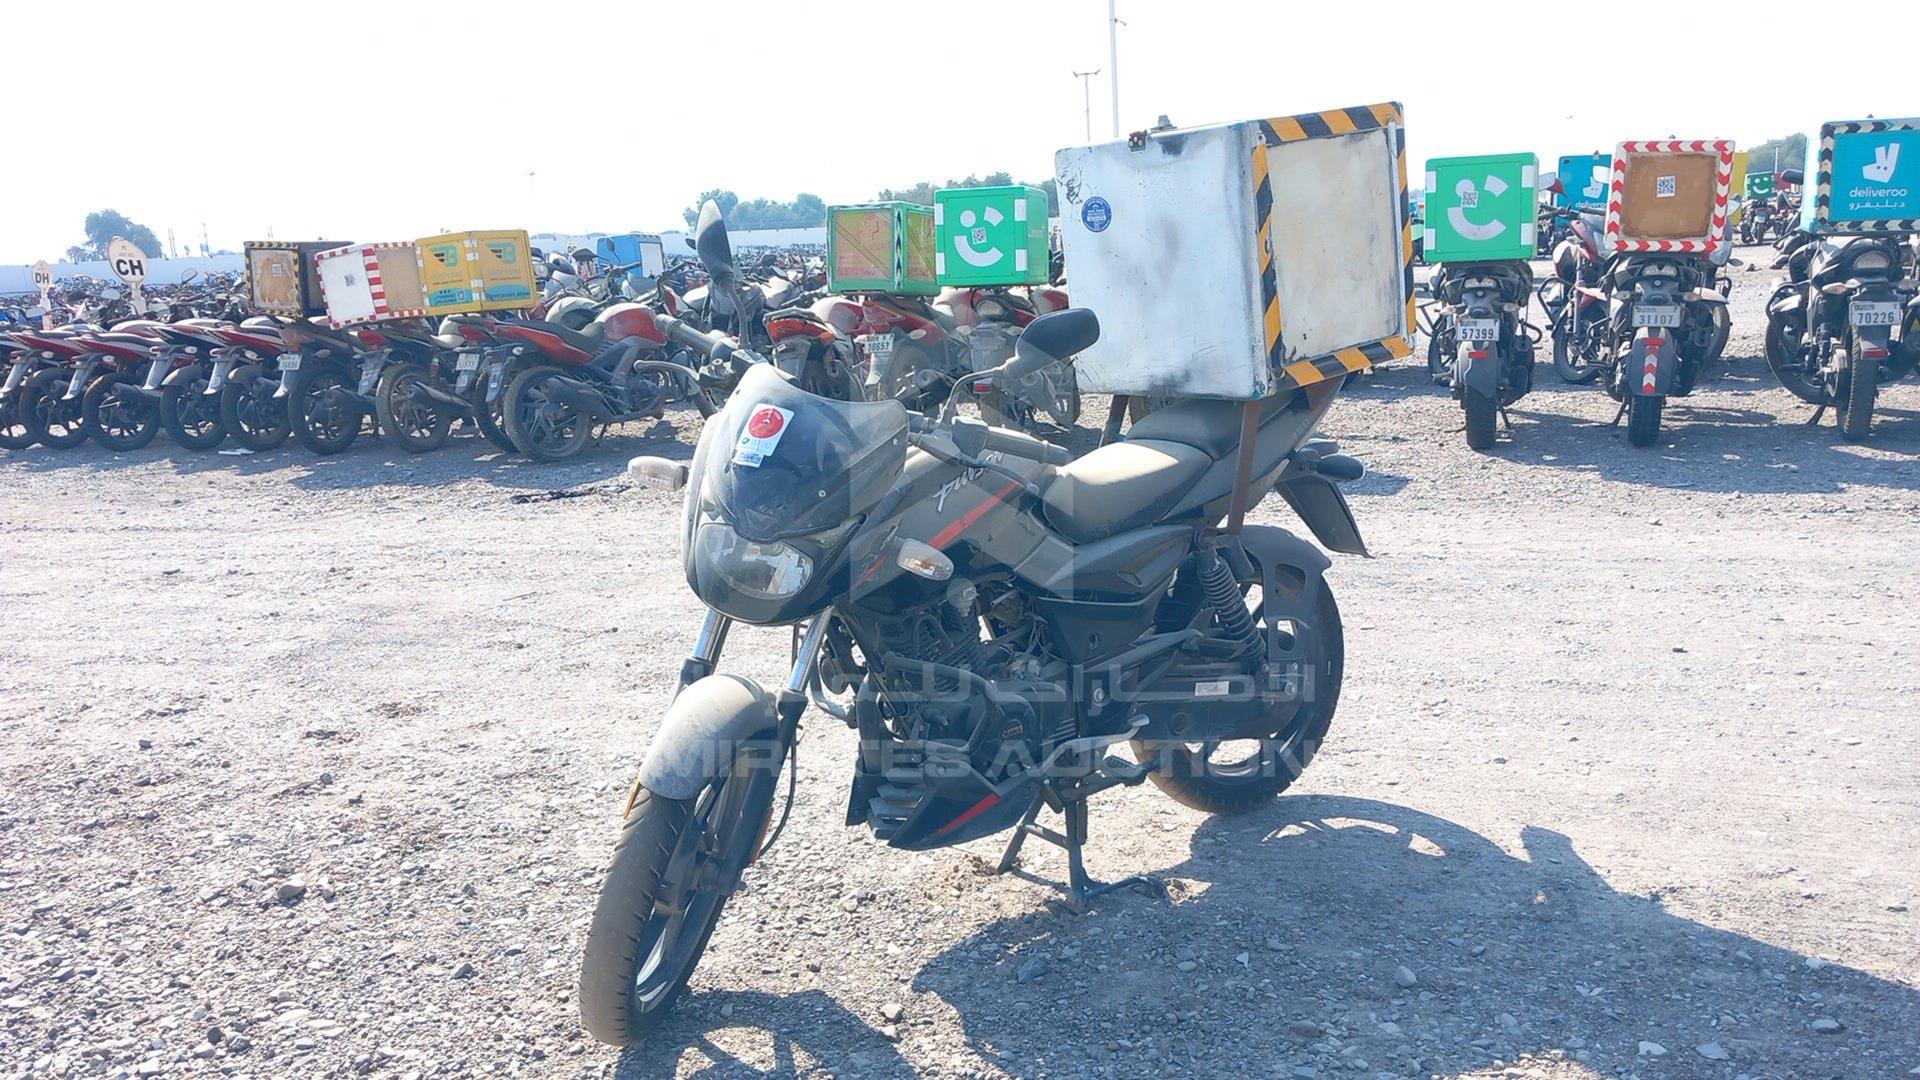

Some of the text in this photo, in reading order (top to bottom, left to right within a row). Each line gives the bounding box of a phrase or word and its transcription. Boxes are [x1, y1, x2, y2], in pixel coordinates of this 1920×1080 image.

[1849, 186, 1908, 198] deliveroo
[115, 259, 145, 276] CH
[34, 272, 50, 284] DH
[1639, 314, 1673, 325] 31107
[1857, 312, 1895, 324] 70226
[1462, 328, 1494, 340] 57399
